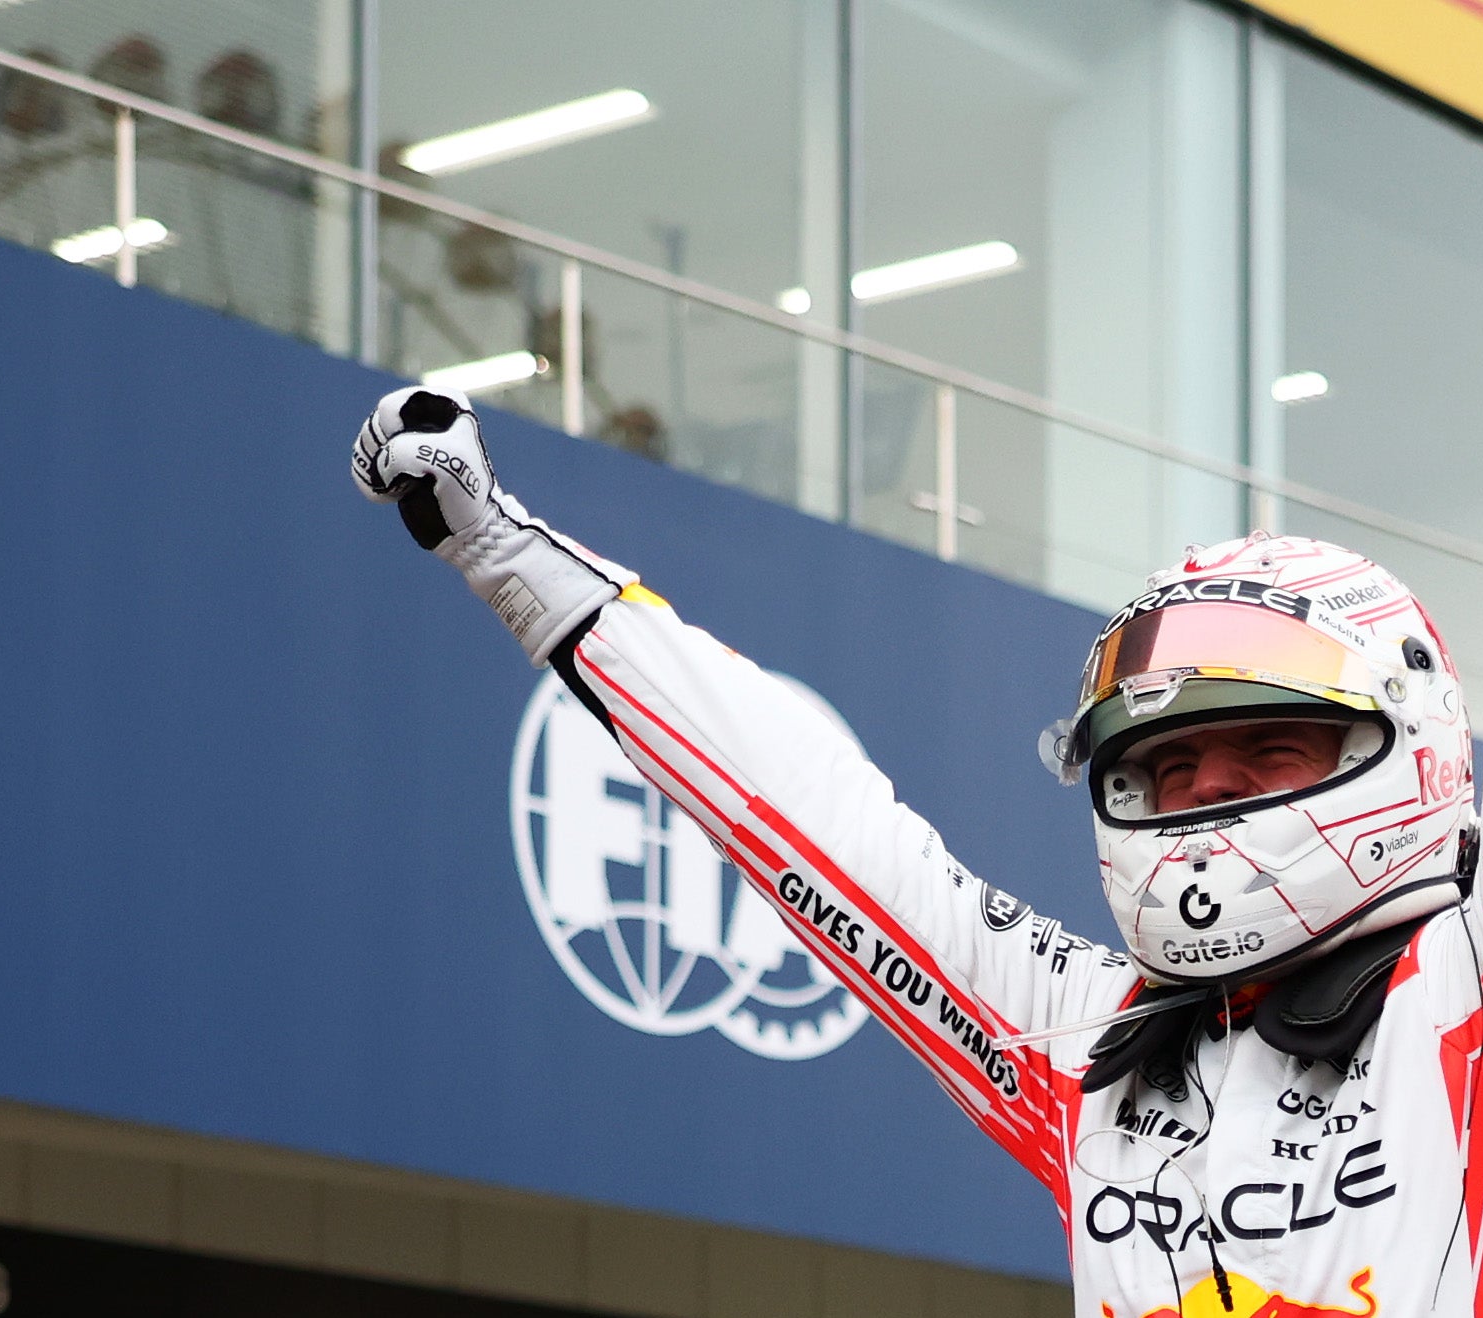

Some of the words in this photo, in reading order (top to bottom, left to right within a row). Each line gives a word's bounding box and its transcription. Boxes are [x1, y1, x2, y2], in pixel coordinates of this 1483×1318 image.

[416, 444, 481, 494] sparco
[1100, 576, 1303, 640] ORACLE
[1384, 829, 1420, 856] viaplay
[1161, 927, 1265, 966] Gate.io
[778, 869, 864, 955] GIVES
[868, 937, 931, 1008] YOU
[938, 996, 1021, 1098] WINGS
[1085, 1138, 1397, 1253] ORACLE
